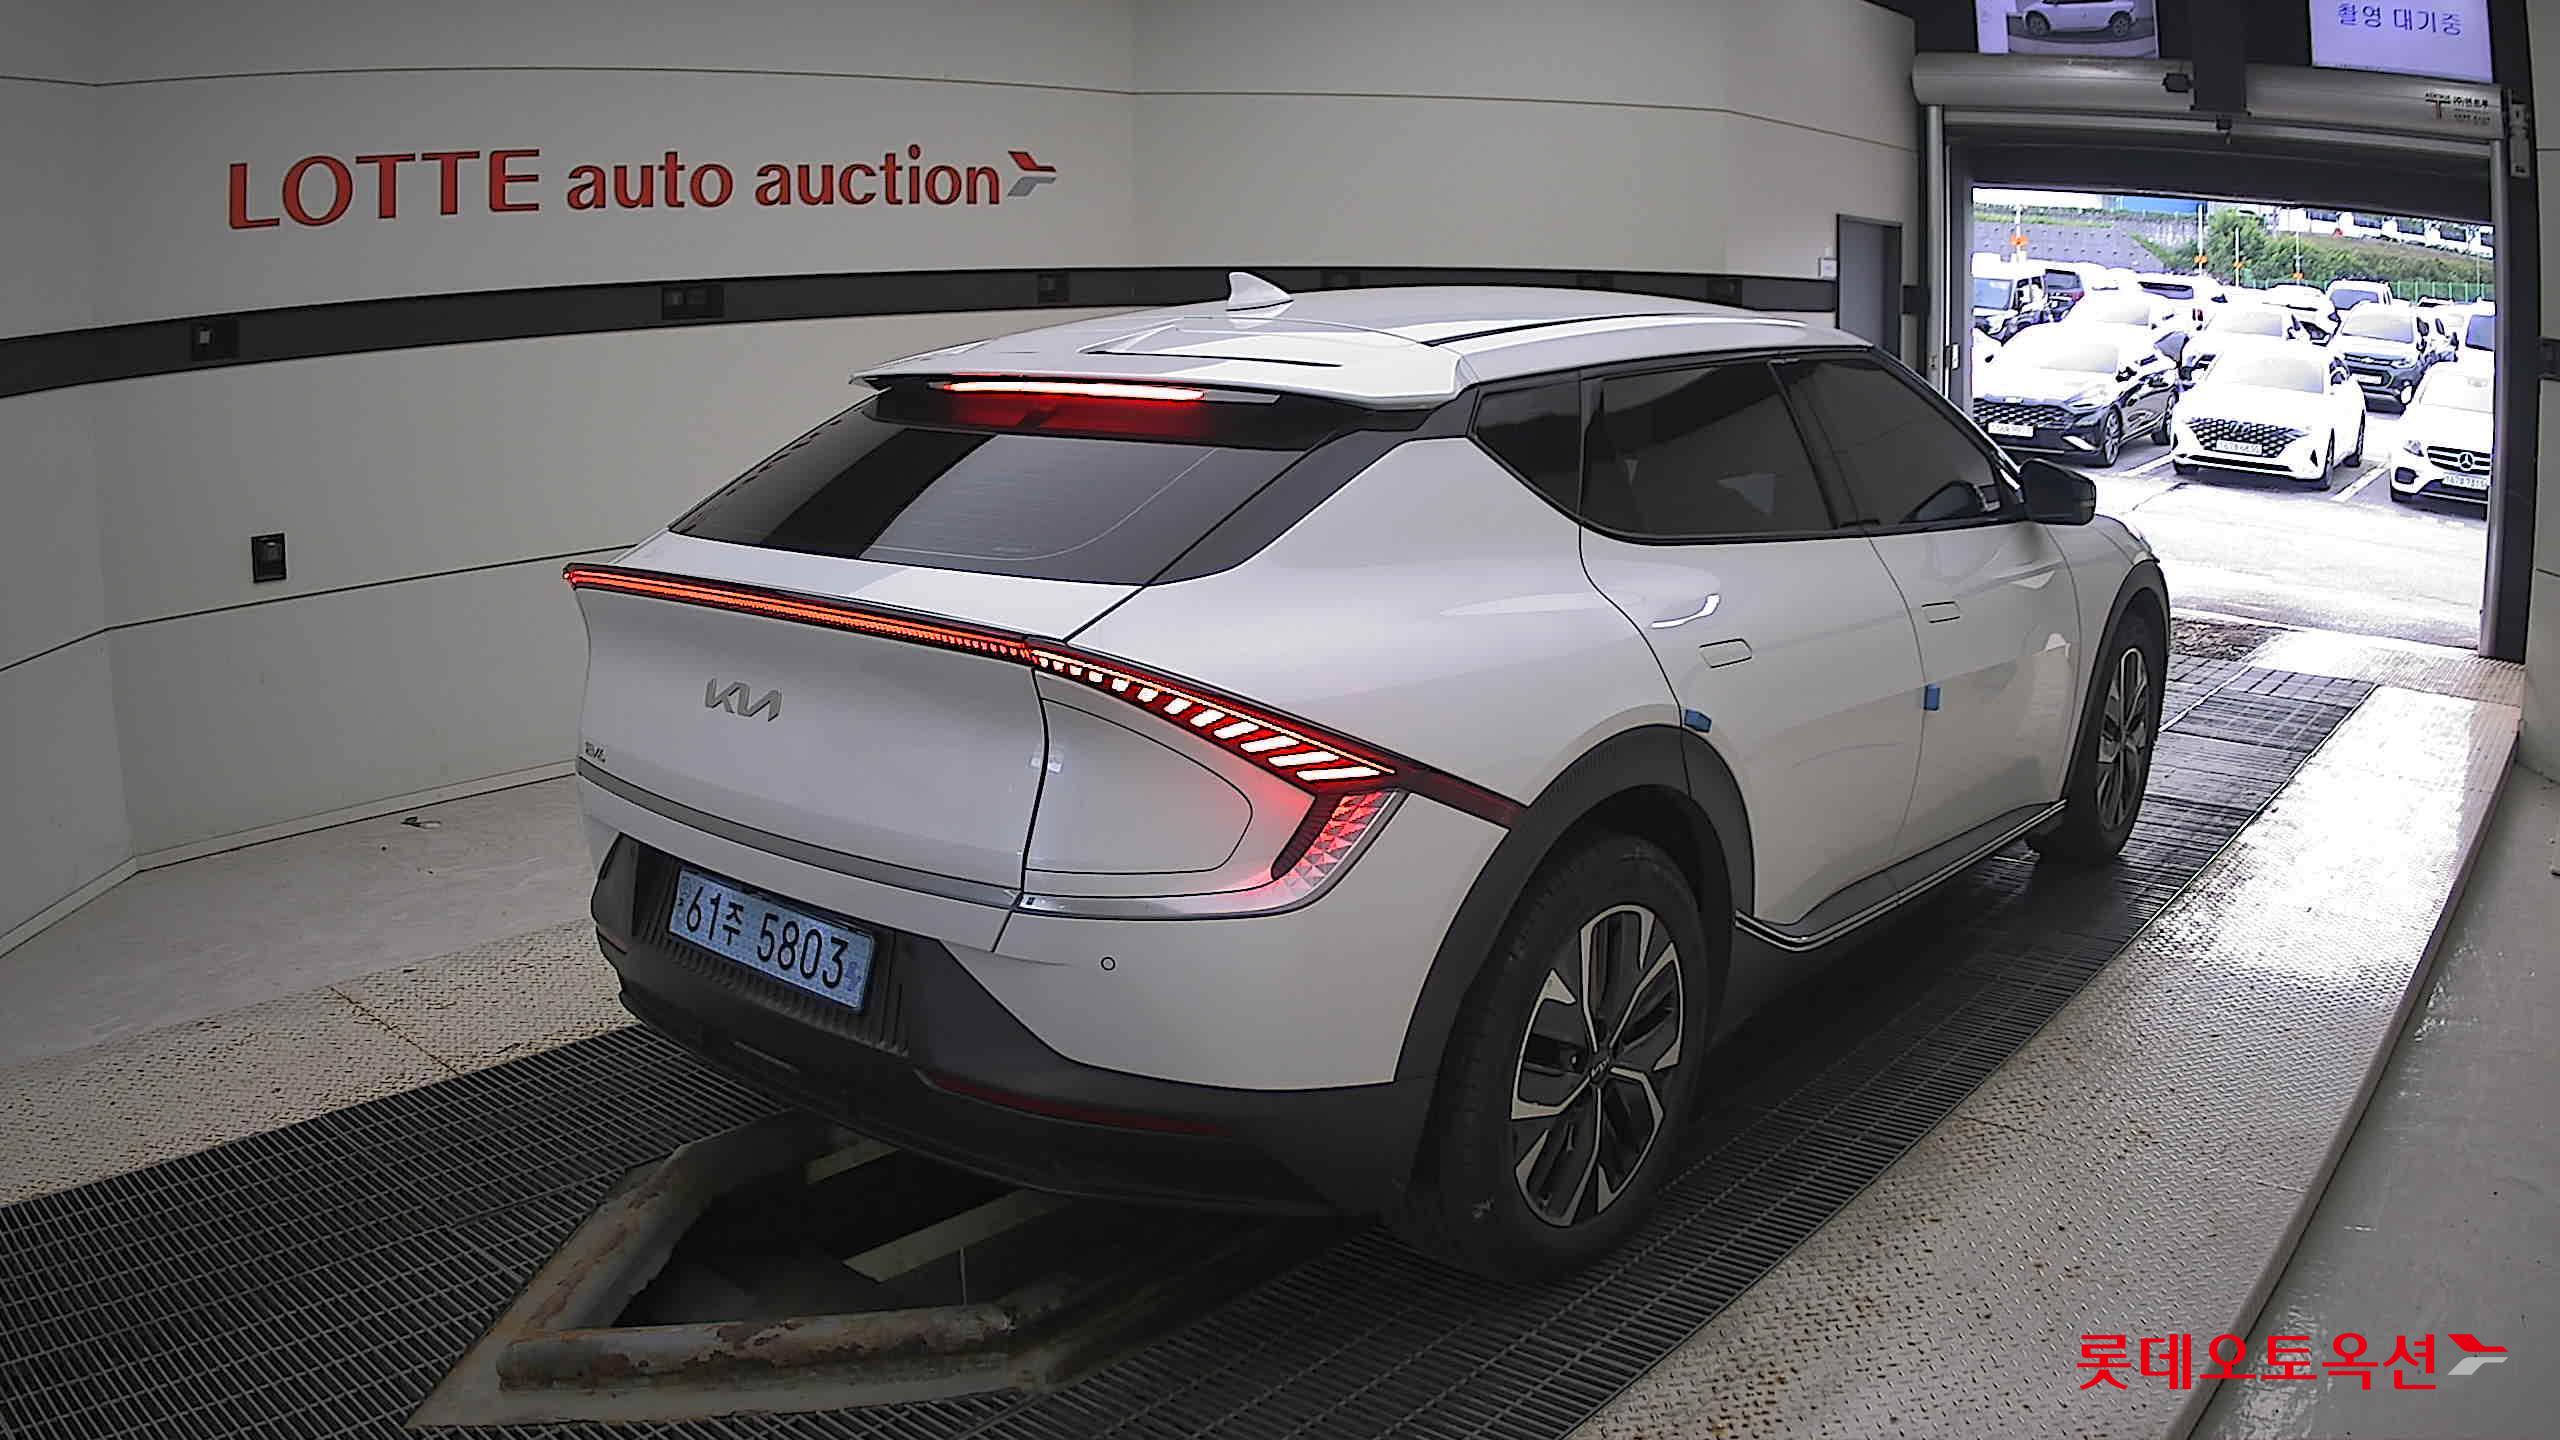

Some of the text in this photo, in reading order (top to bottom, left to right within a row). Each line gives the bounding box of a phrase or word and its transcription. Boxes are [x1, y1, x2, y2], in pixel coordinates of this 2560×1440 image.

[2338, 4, 2463, 36] 촬영 대기중
[229, 144, 1001, 230] LOTTE auto auction
[704, 678, 782, 722] KIA
[685, 885, 849, 989] 61주 5803
